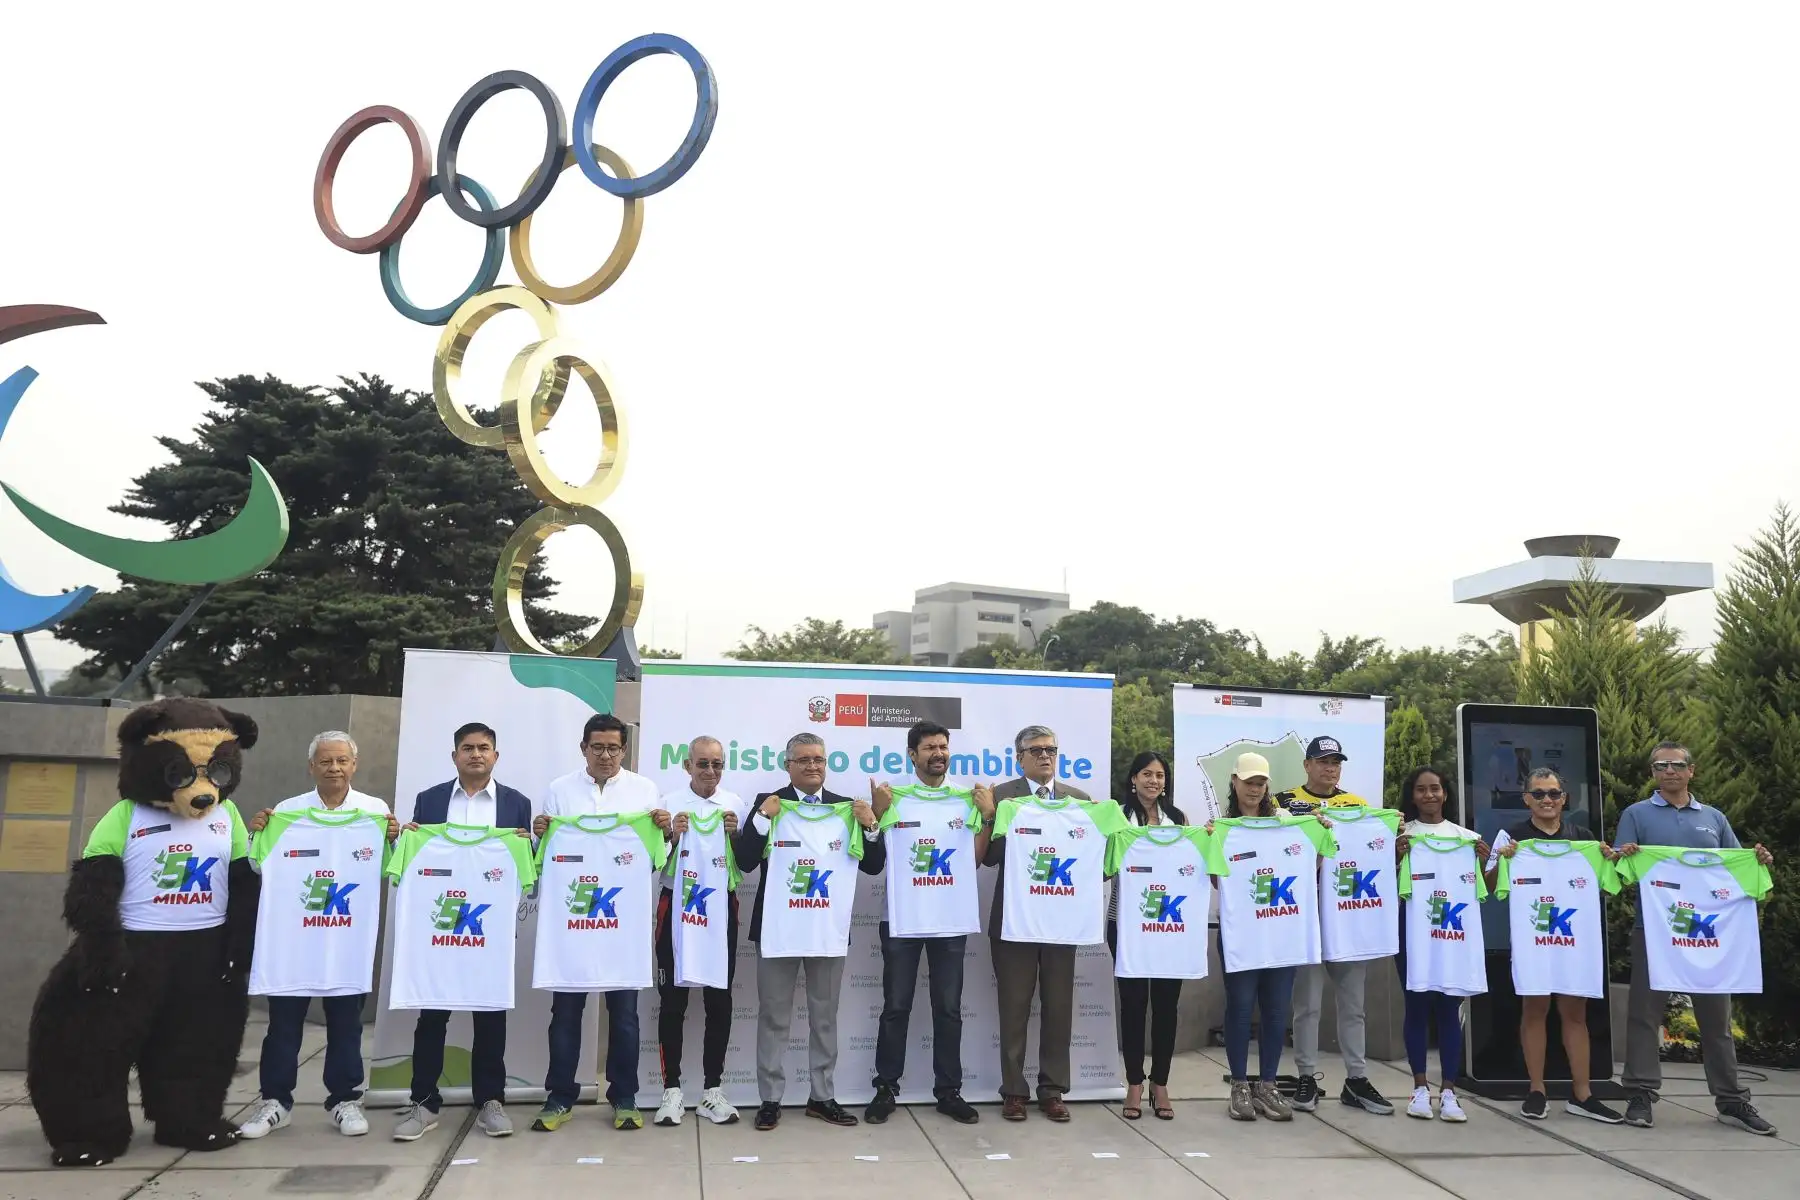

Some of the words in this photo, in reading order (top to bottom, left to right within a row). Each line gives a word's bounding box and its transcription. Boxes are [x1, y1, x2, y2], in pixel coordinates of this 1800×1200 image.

[839, 705, 864, 715] PERÚ
[871, 706, 911, 715] Ministerio
[871, 714, 884, 722] del
[885, 715, 923, 723] Ambiente
[168, 843, 193, 853] ECO
[1038, 846, 1056, 854] ECO
[912, 845, 957, 876] 5K
[1339, 861, 1357, 869] ECO
[156, 852, 220, 892] 5K
[315, 870, 335, 878] ECO
[682, 870, 698, 878] ECO
[1030, 854, 1078, 886] 5K
[1256, 867, 1274, 876] ECO
[579, 875, 599, 883] ECO
[790, 866, 833, 899] 5K
[912, 876, 954, 887] MINAM
[1337, 868, 1382, 899] 5K
[304, 878, 360, 915] 5K
[446, 890, 467, 898] ECO
[1029, 885, 1075, 897] MINAM
[1254, 874, 1299, 906] 5K
[1433, 890, 1448, 898] ECO
[152, 892, 213, 905] MINAM
[569, 883, 624, 918] 5K
[1337, 898, 1383, 912] MINAM
[1677, 901, 1696, 909] ECO
[1142, 891, 1188, 923] 5K
[1255, 905, 1300, 920] MINAM
[434, 898, 493, 936] 5K
[681, 912, 708, 927] NAM
[1430, 897, 1469, 931] 5K
[1535, 903, 1579, 937] 5K
[303, 915, 352, 928] MINAM
[567, 918, 619, 930] MINAM
[1141, 922, 1185, 933] MINAM
[1671, 907, 1720, 938] 5K
[431, 935, 486, 948] MINAM
[1671, 937, 1720, 948] MINAM
